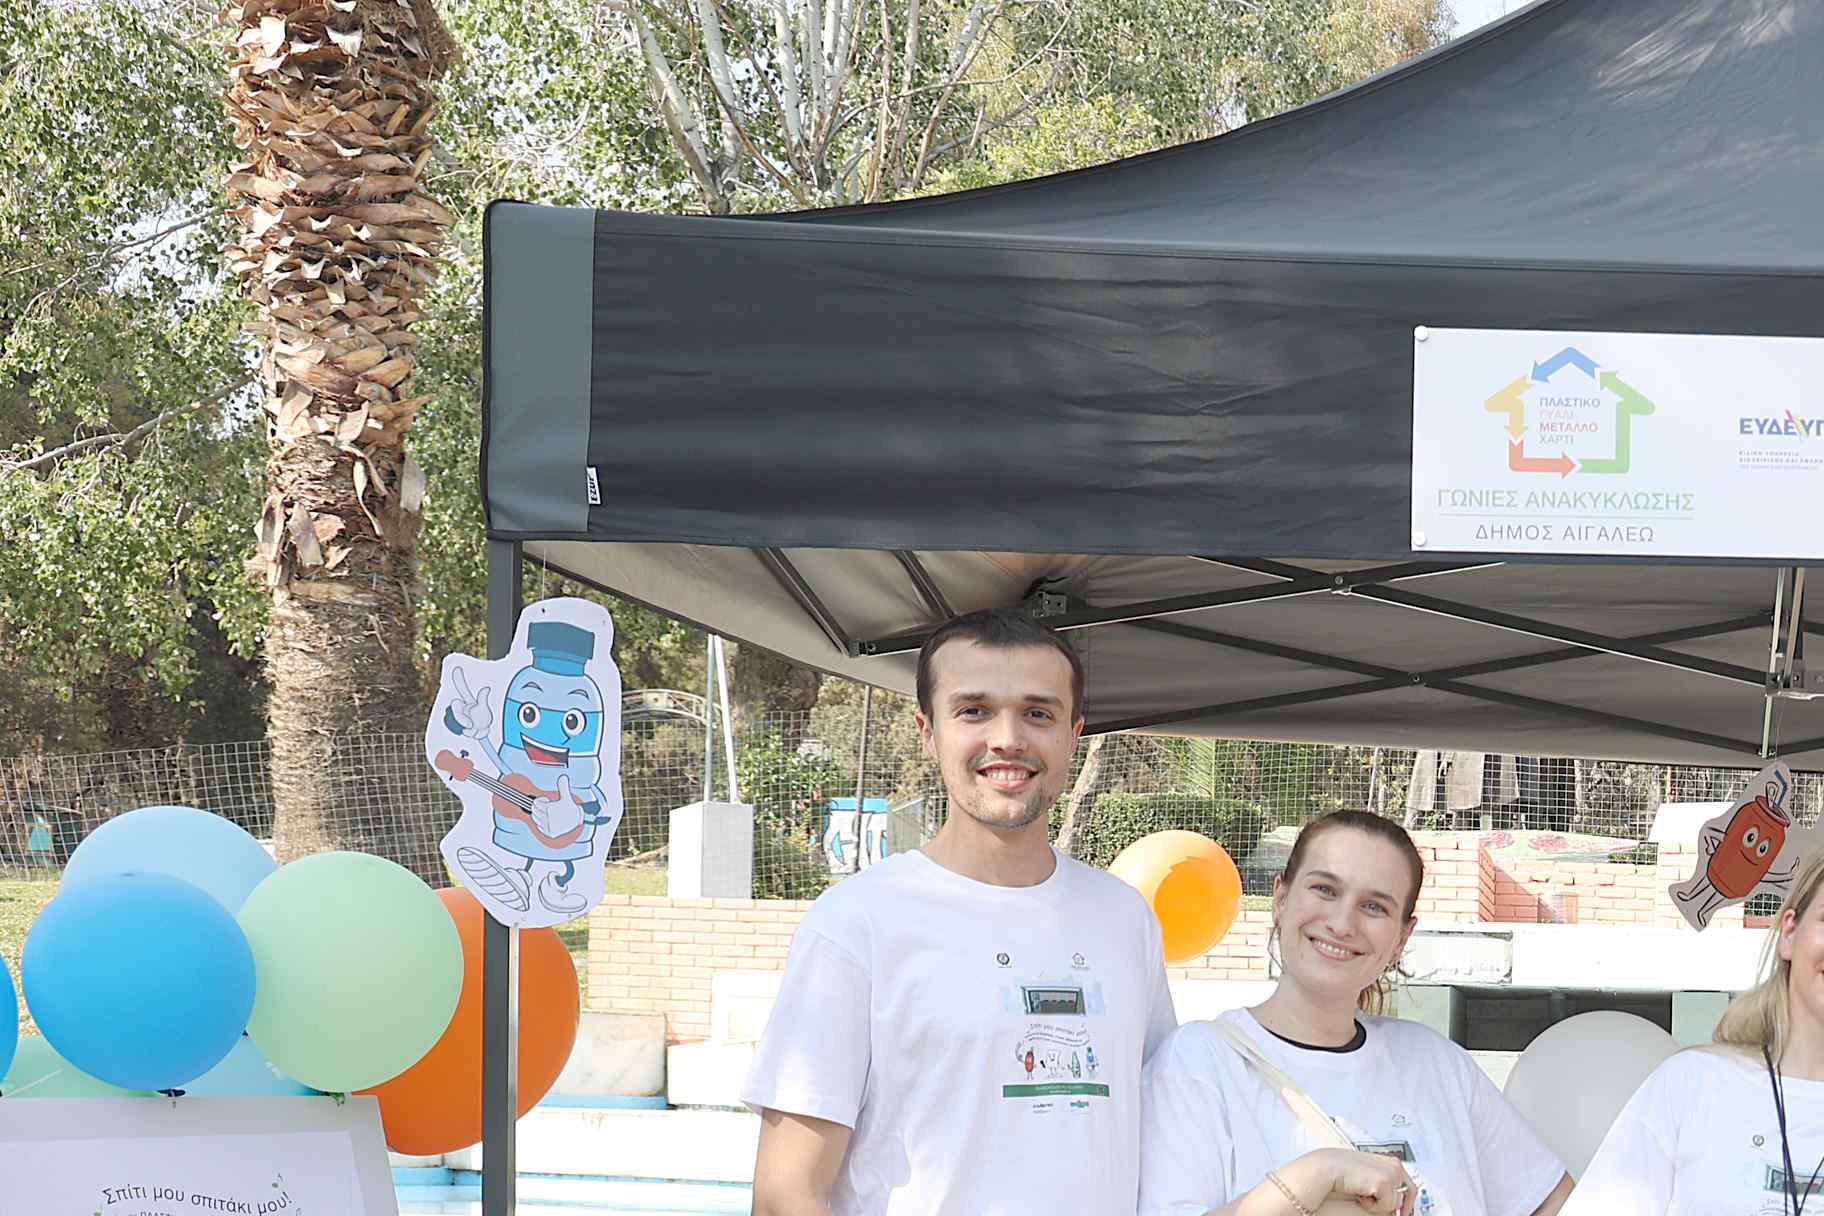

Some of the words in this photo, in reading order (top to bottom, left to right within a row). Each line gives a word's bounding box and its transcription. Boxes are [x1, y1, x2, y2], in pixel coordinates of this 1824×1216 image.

[1538, 397, 1601, 409] ΠΛΑΣΤΙΚΟ
[1538, 422, 1599, 433] ΜΕΤΑΛΛΟ
[1538, 434, 1575, 446] ΧΑΡΤΙ
[1437, 488, 1520, 509] ΓΩΝΙΕΣ
[1525, 489, 1695, 512] ΑΝΑΚΥΚΛΩΣΗΣ
[1474, 523, 1554, 541] ΔΗΜΟΣ
[1561, 524, 1657, 543] ΑΙΓΑΛΕΩ
[102, 1183, 148, 1205] Σπίτι
[152, 1185, 185, 1202] μου
[190, 1193, 252, 1215] σπιτάκι
[256, 1191, 293, 1216] μου!
